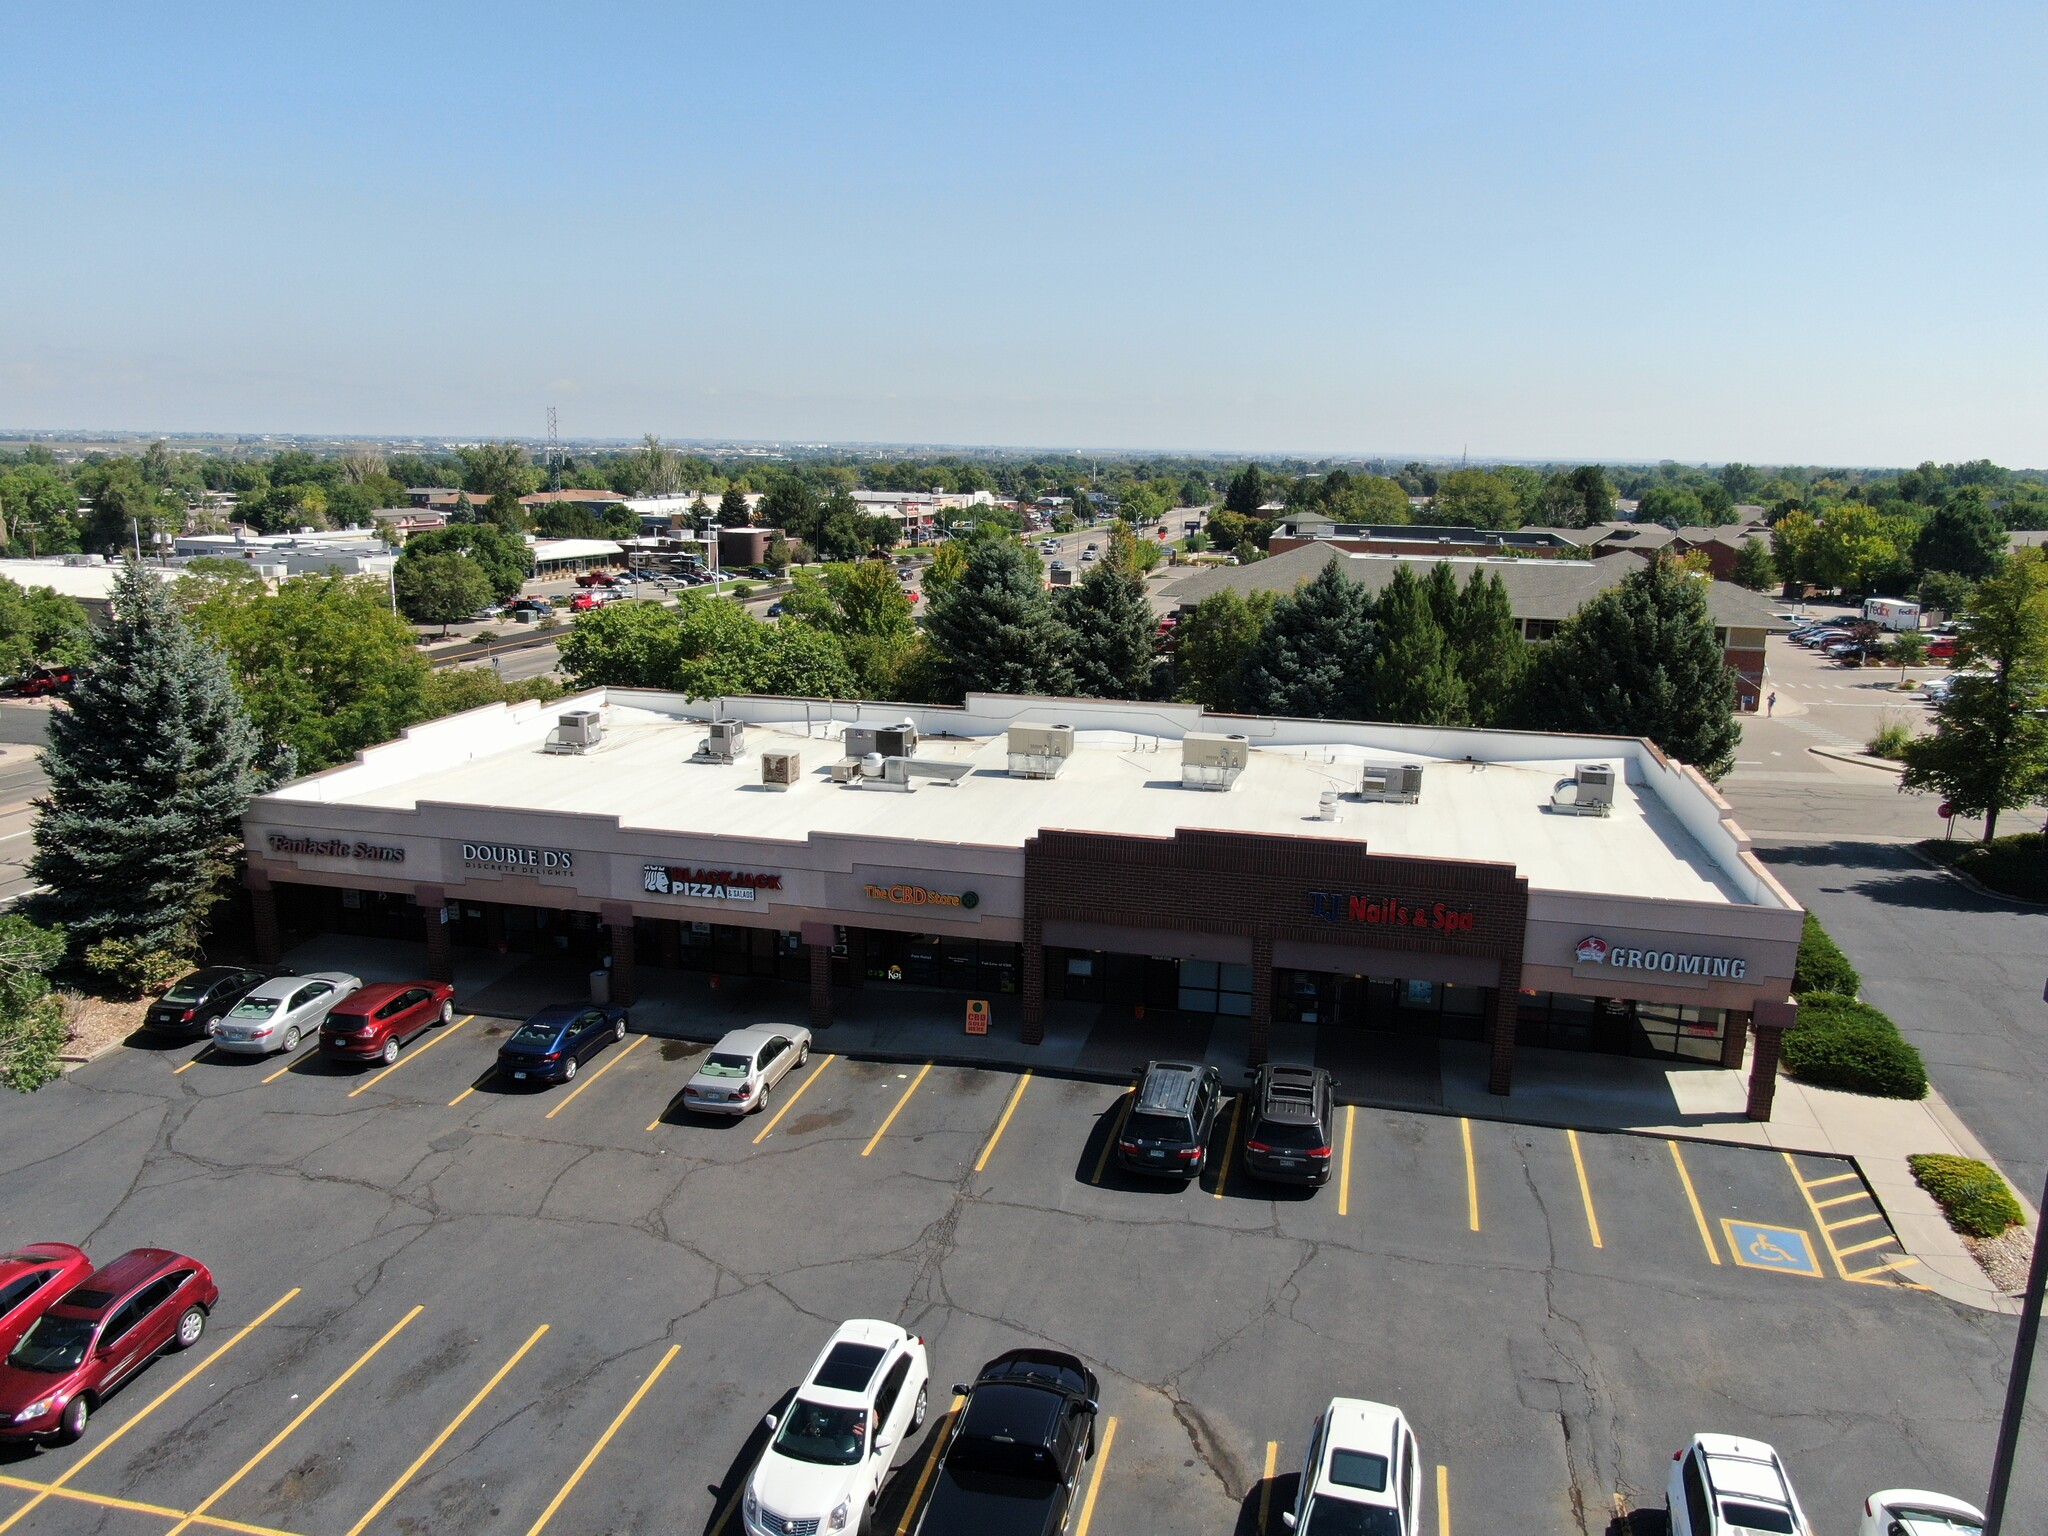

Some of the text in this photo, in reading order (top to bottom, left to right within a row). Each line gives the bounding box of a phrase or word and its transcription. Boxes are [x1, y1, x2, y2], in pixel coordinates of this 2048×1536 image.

[1870, 601, 1890, 618] FedEx
[1898, 608, 1919, 616] FedEx
[268, 834, 405, 863] Fantastic Sams
[462, 844, 572, 869] DOUBLE D'S
[465, 862, 575, 877] DISCRETE DELIGHTS
[672, 867, 783, 890] BLACKJACK
[672, 881, 726, 899] PIZZA
[733, 889, 754, 899] SALADS
[864, 884, 961, 907] The CBD Store
[1309, 892, 1473, 936] TJ Nails & Spa
[1611, 947, 1747, 979] GROOMING
[887, 970, 902, 980] Koi
[967, 1013, 986, 1021] CBD
